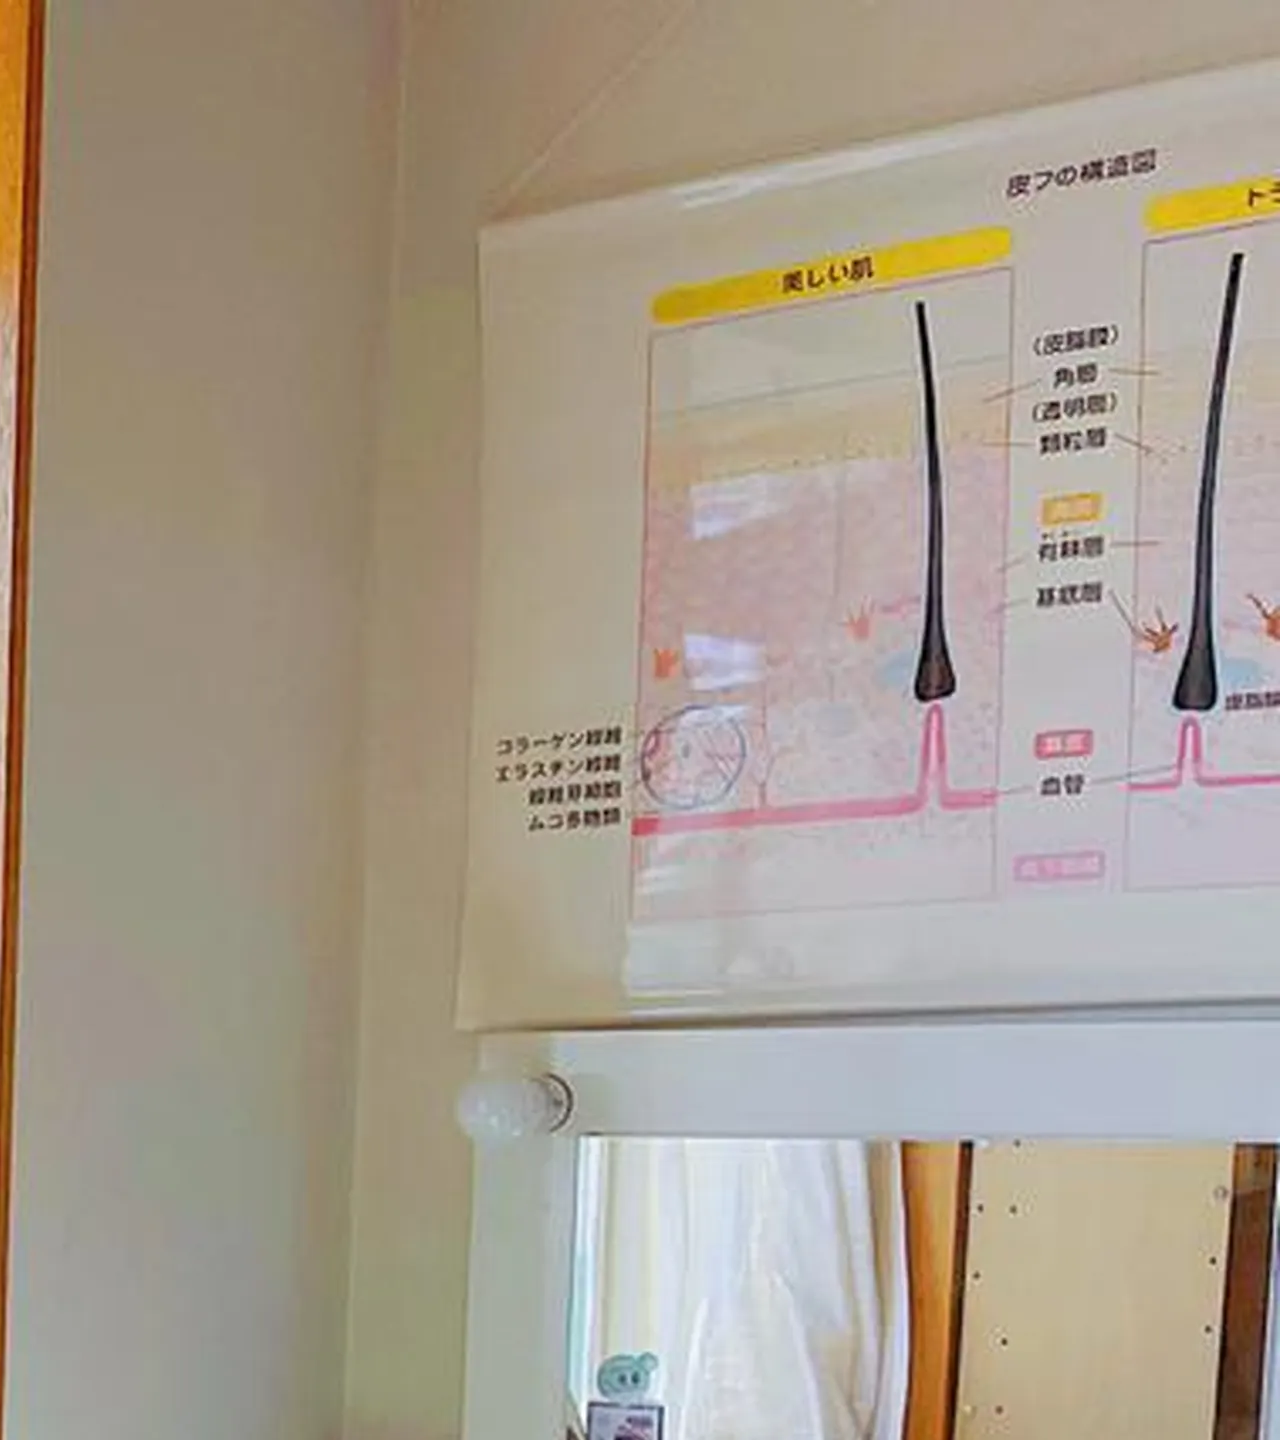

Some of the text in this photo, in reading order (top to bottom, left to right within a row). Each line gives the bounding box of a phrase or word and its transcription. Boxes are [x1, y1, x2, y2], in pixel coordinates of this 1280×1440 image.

[1006, 148, 1158, 199] 皮フの構造図
[781, 255, 874, 294] 美しい肌
